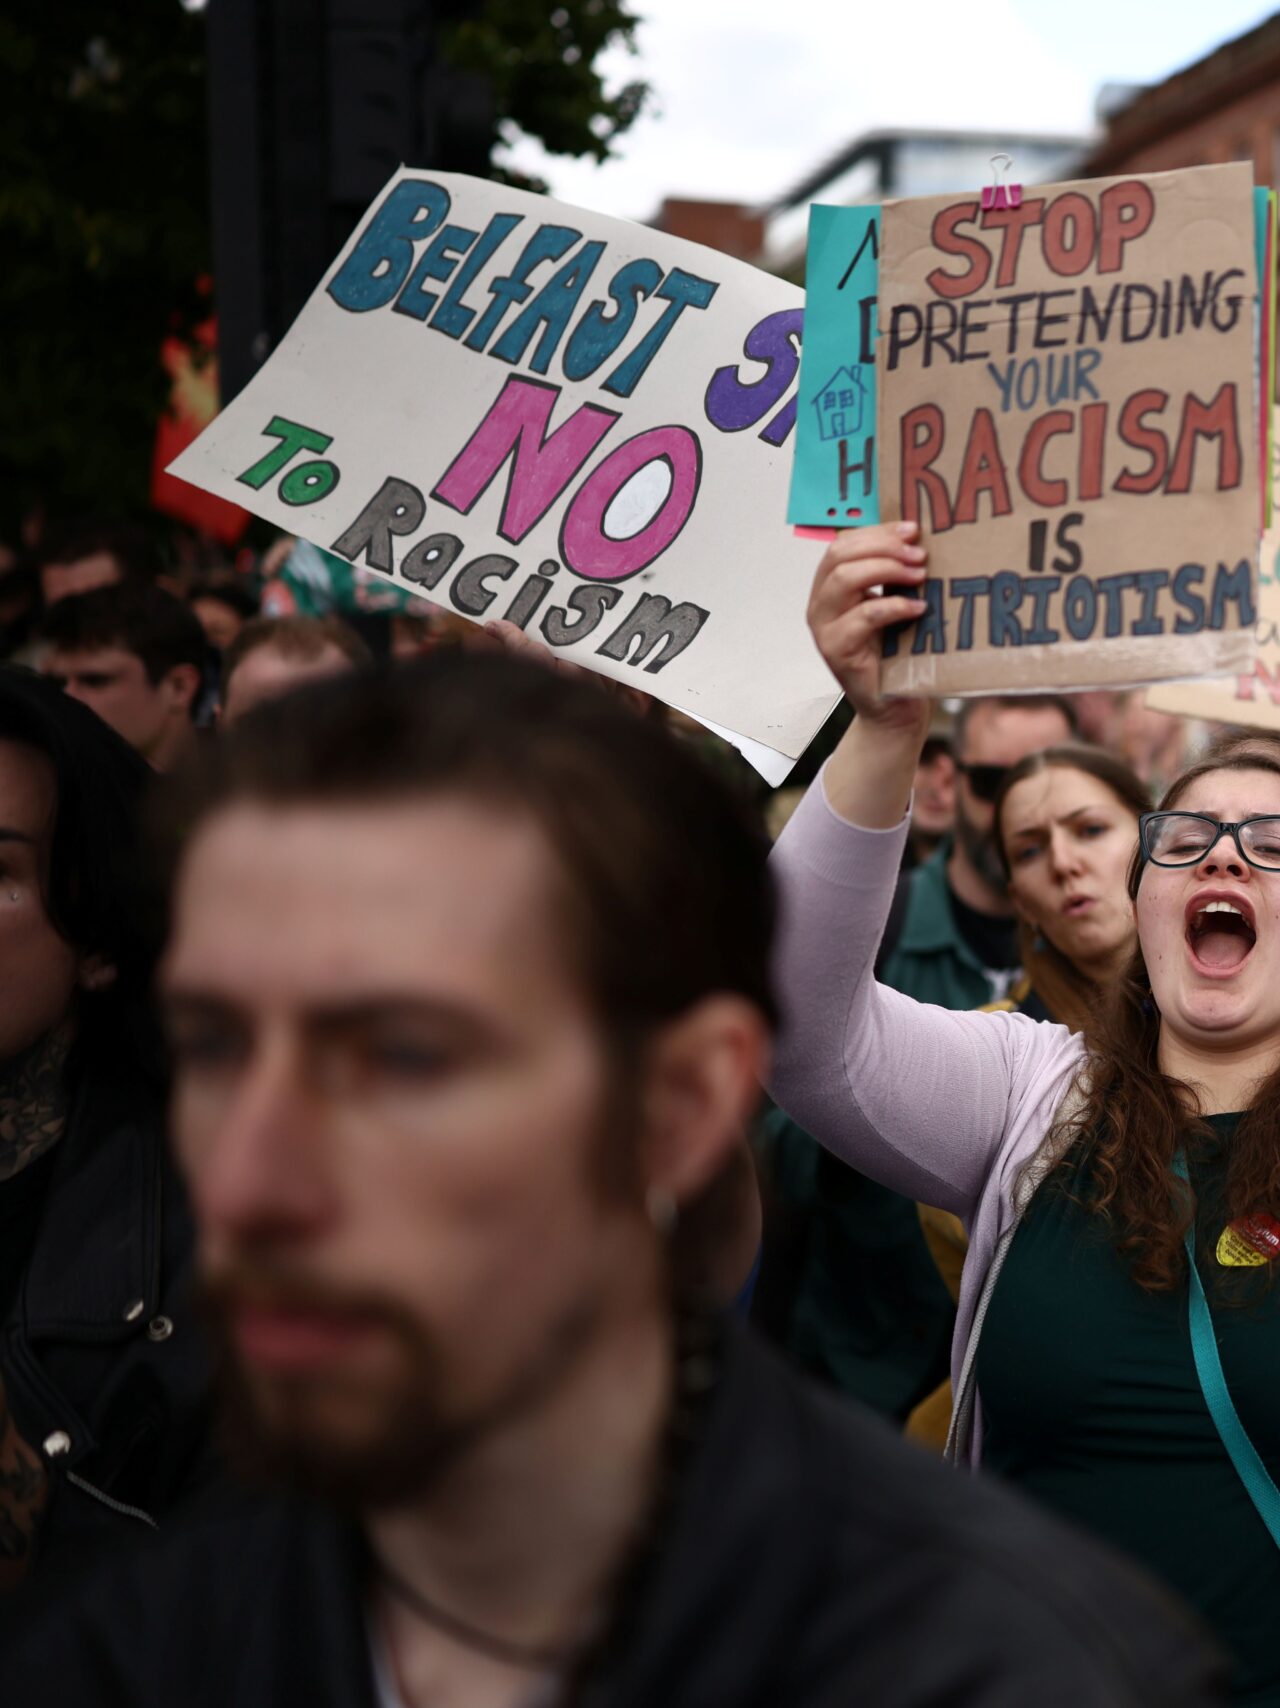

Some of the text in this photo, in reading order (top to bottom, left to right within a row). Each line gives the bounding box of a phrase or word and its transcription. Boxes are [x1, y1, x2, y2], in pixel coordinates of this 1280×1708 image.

[926, 180, 1155, 298] STOP
[704, 308, 805, 447] S
[886, 269, 1246, 371] PRETENDING
[986, 348, 1102, 412] YOUR
[429, 372, 703, 584] NO
[900, 382, 1242, 533] RACISM
[330, 477, 710, 674] Racism
[1029, 513, 1083, 573] IS
